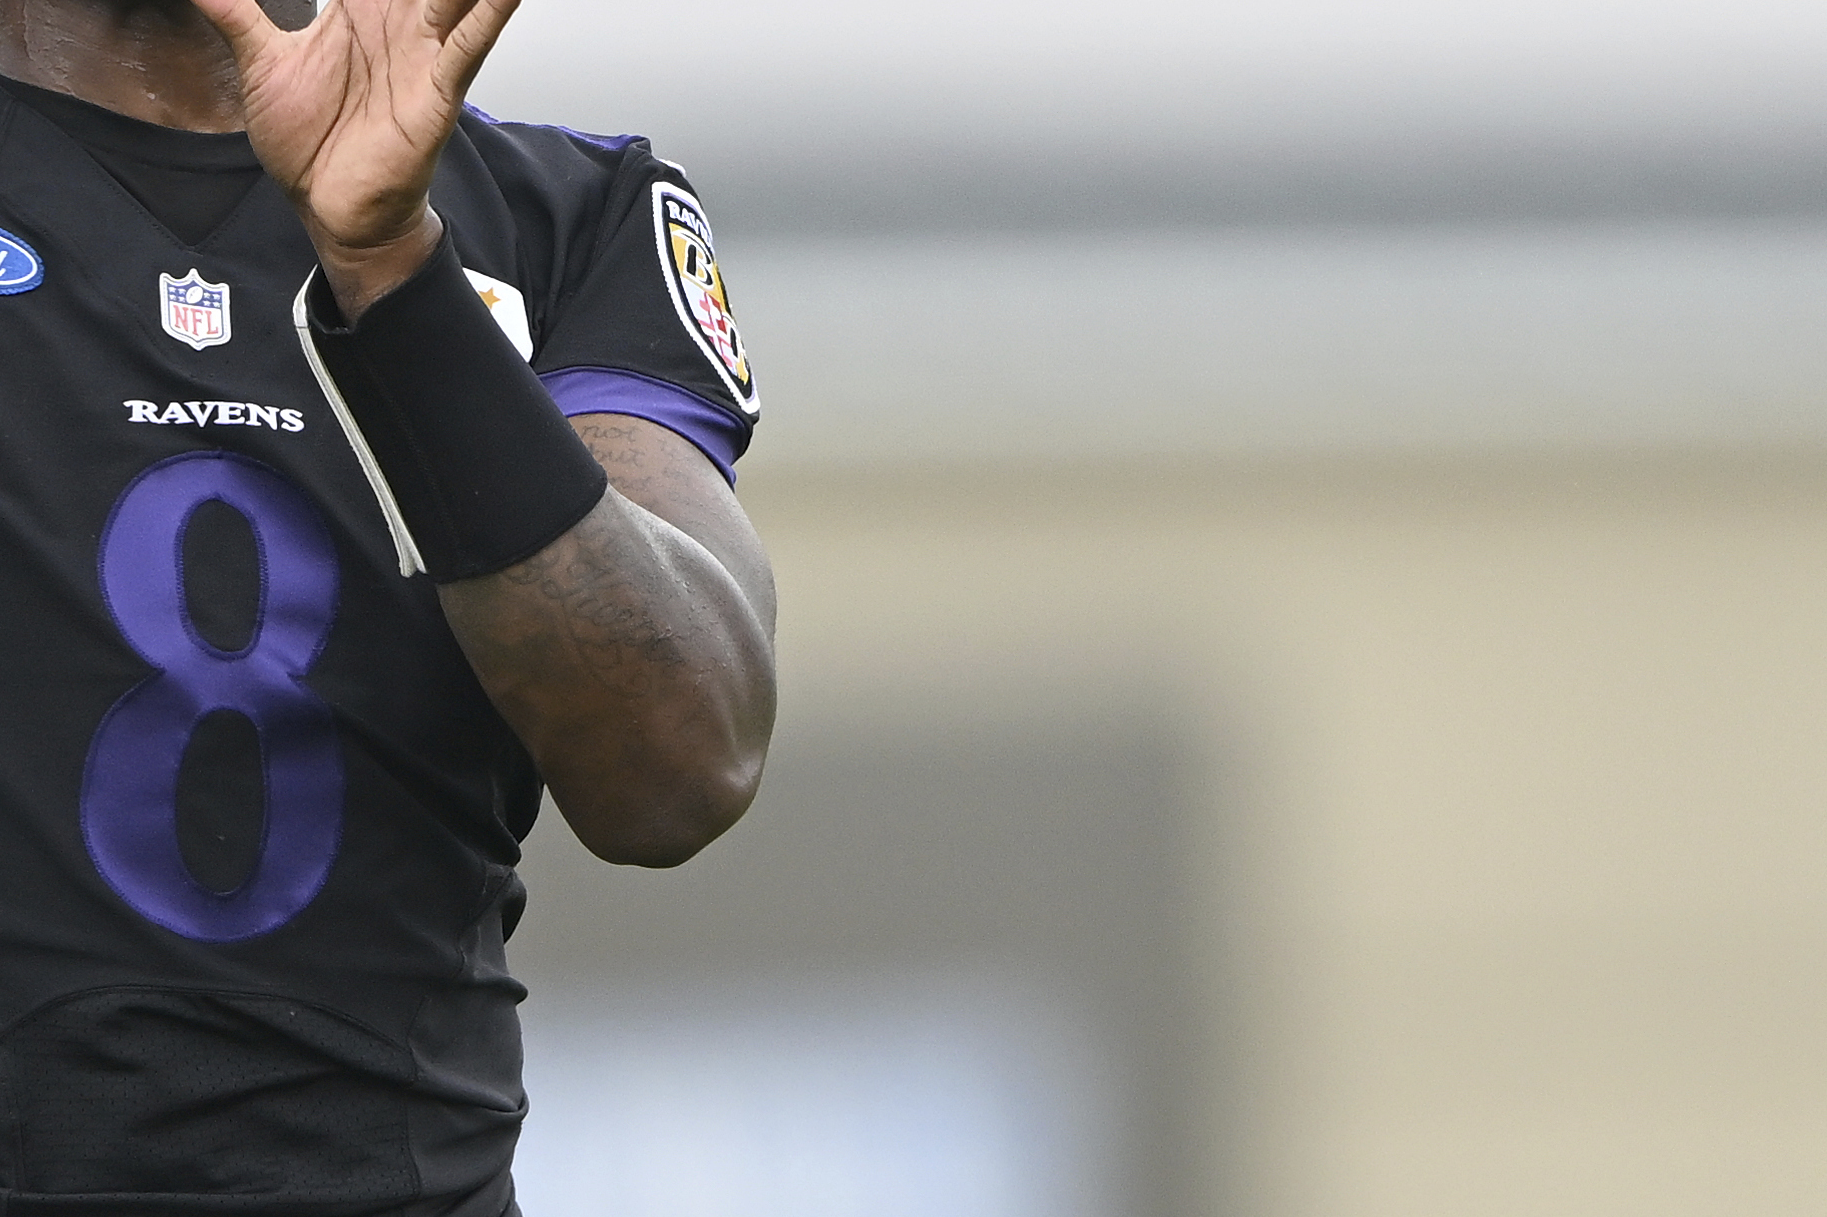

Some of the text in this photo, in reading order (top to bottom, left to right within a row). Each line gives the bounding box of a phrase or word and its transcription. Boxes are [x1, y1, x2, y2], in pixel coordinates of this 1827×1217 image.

[172, 304, 220, 336] NFL
[122, 399, 305, 433] RAVENS
[80, 450, 346, 943] 8
